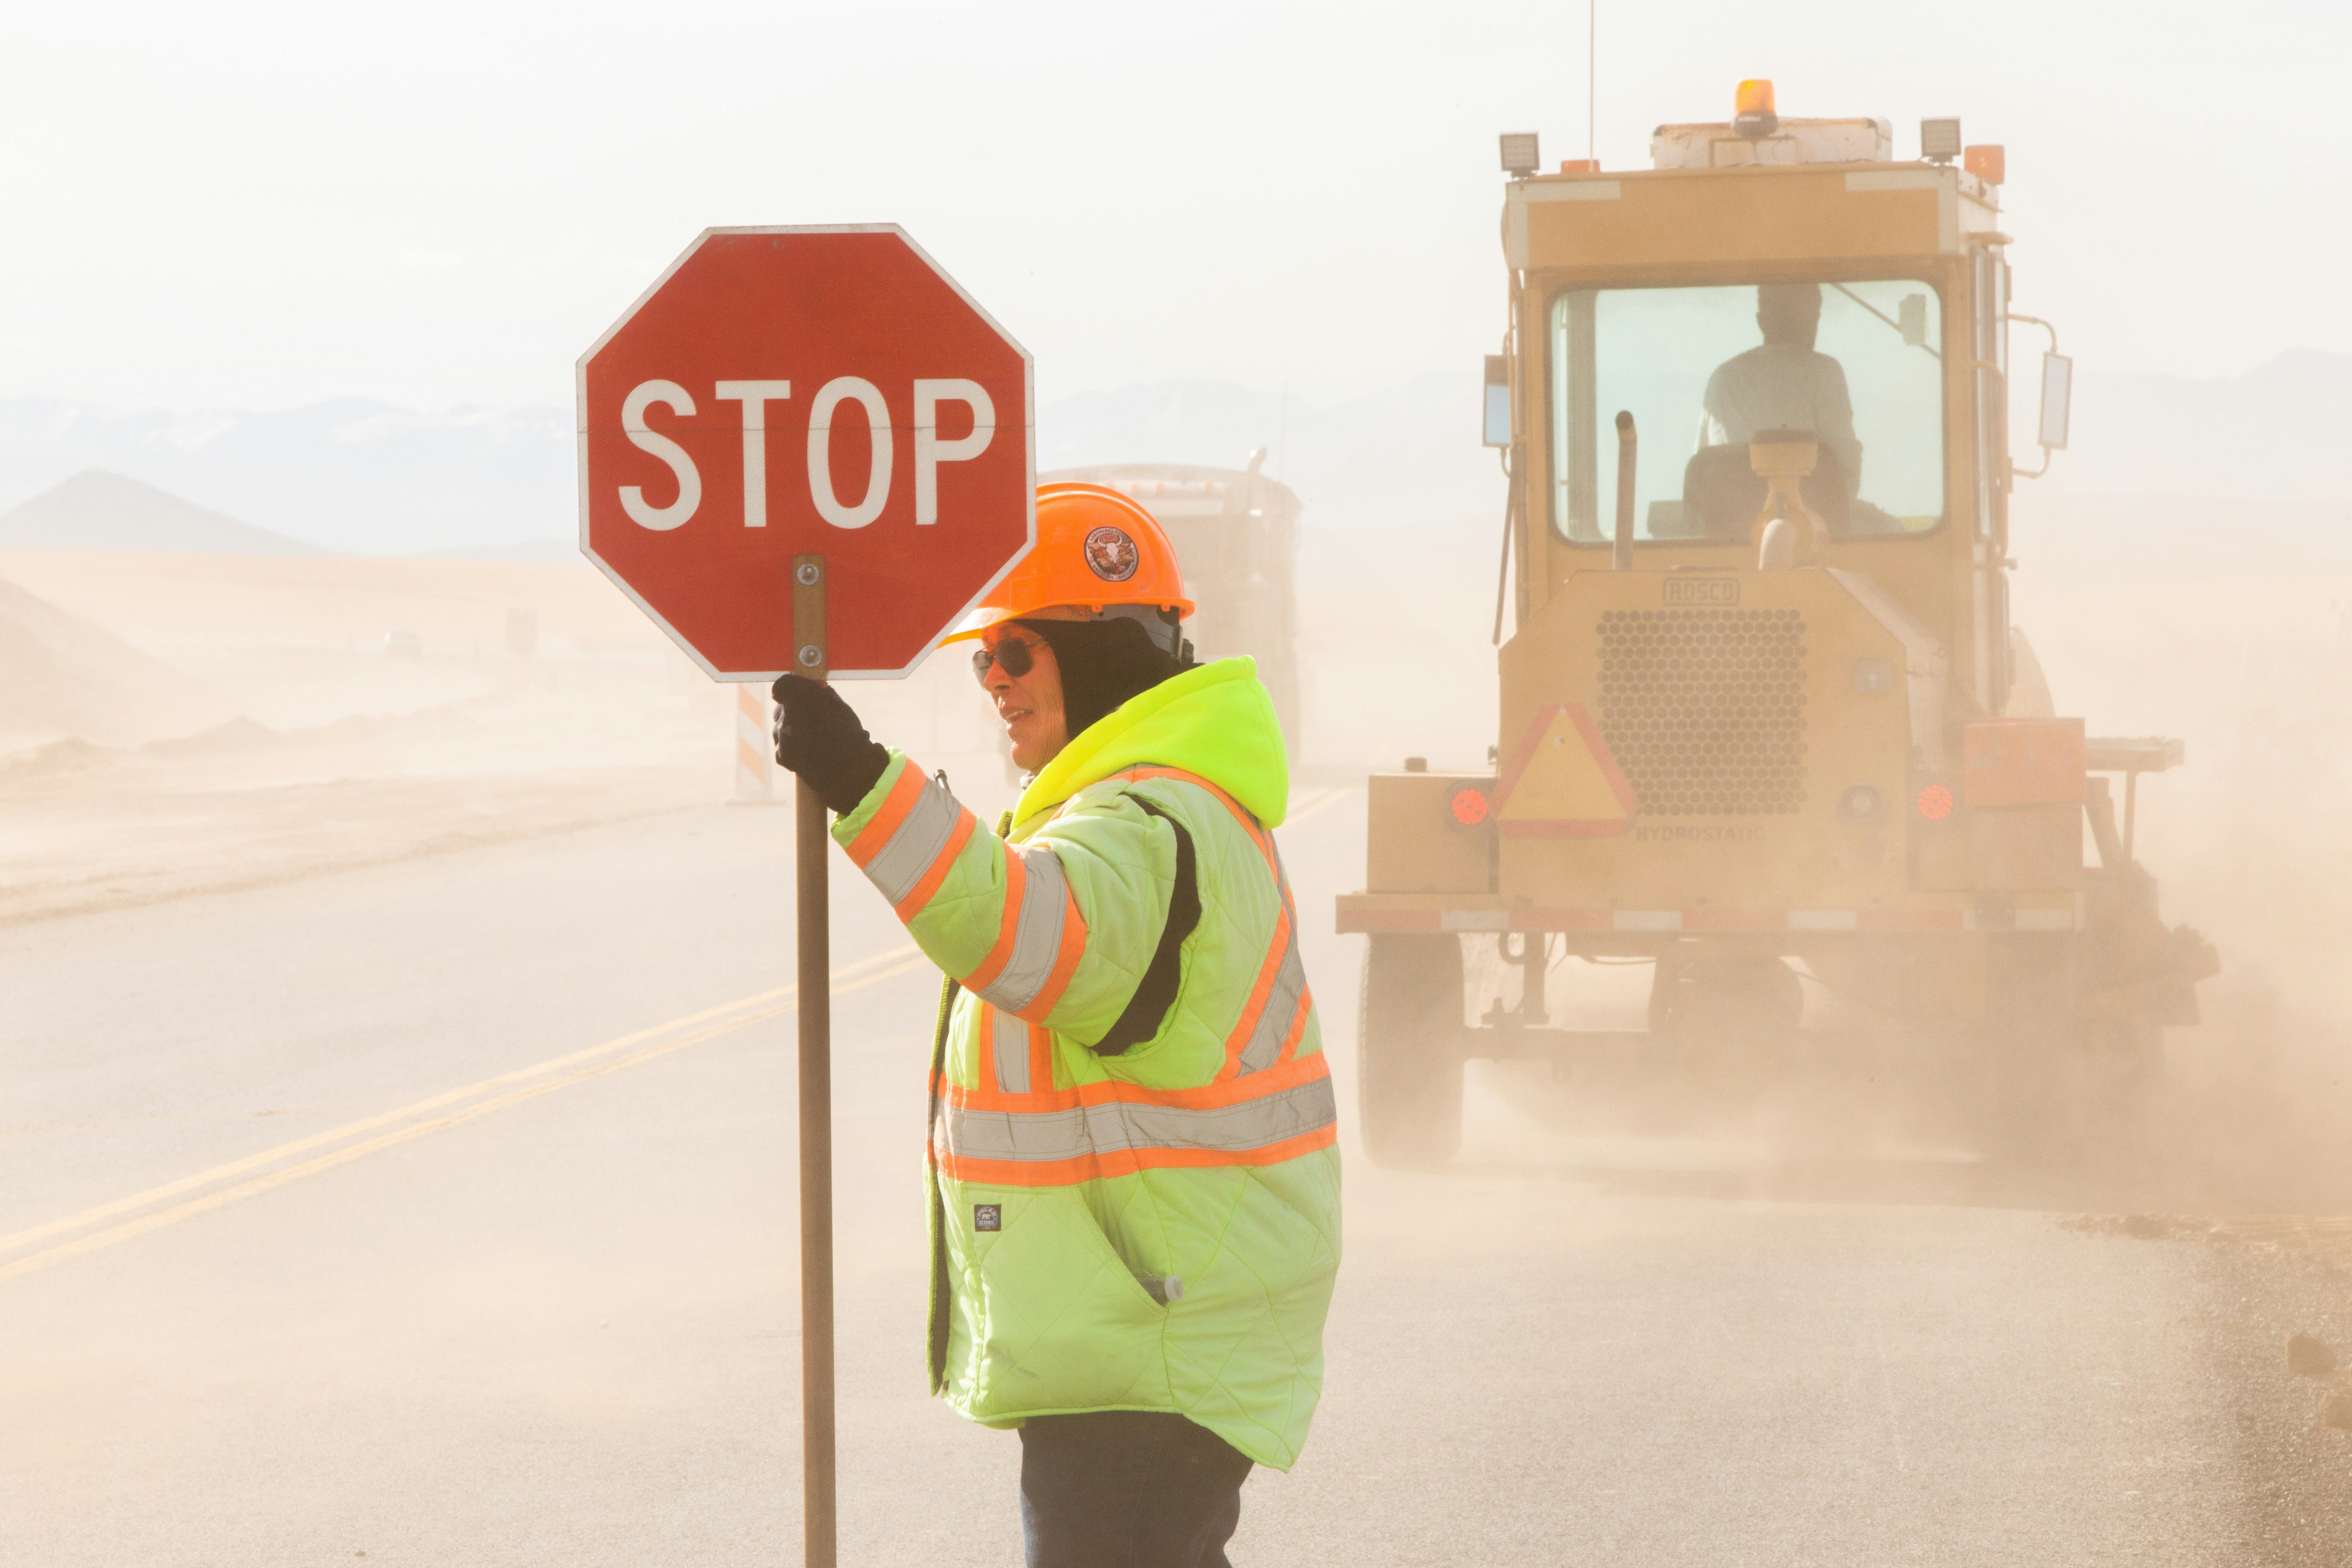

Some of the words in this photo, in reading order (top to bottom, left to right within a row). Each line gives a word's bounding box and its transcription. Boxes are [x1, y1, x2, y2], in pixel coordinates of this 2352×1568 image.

[619, 376, 996, 531] STOP
[1089, 529, 1110, 541] LABORERS
[1670, 582, 1733, 600] ROSCO
[1636, 826, 1765, 841] HYDROSTATIC
[977, 1207, 997, 1217] POLAR
